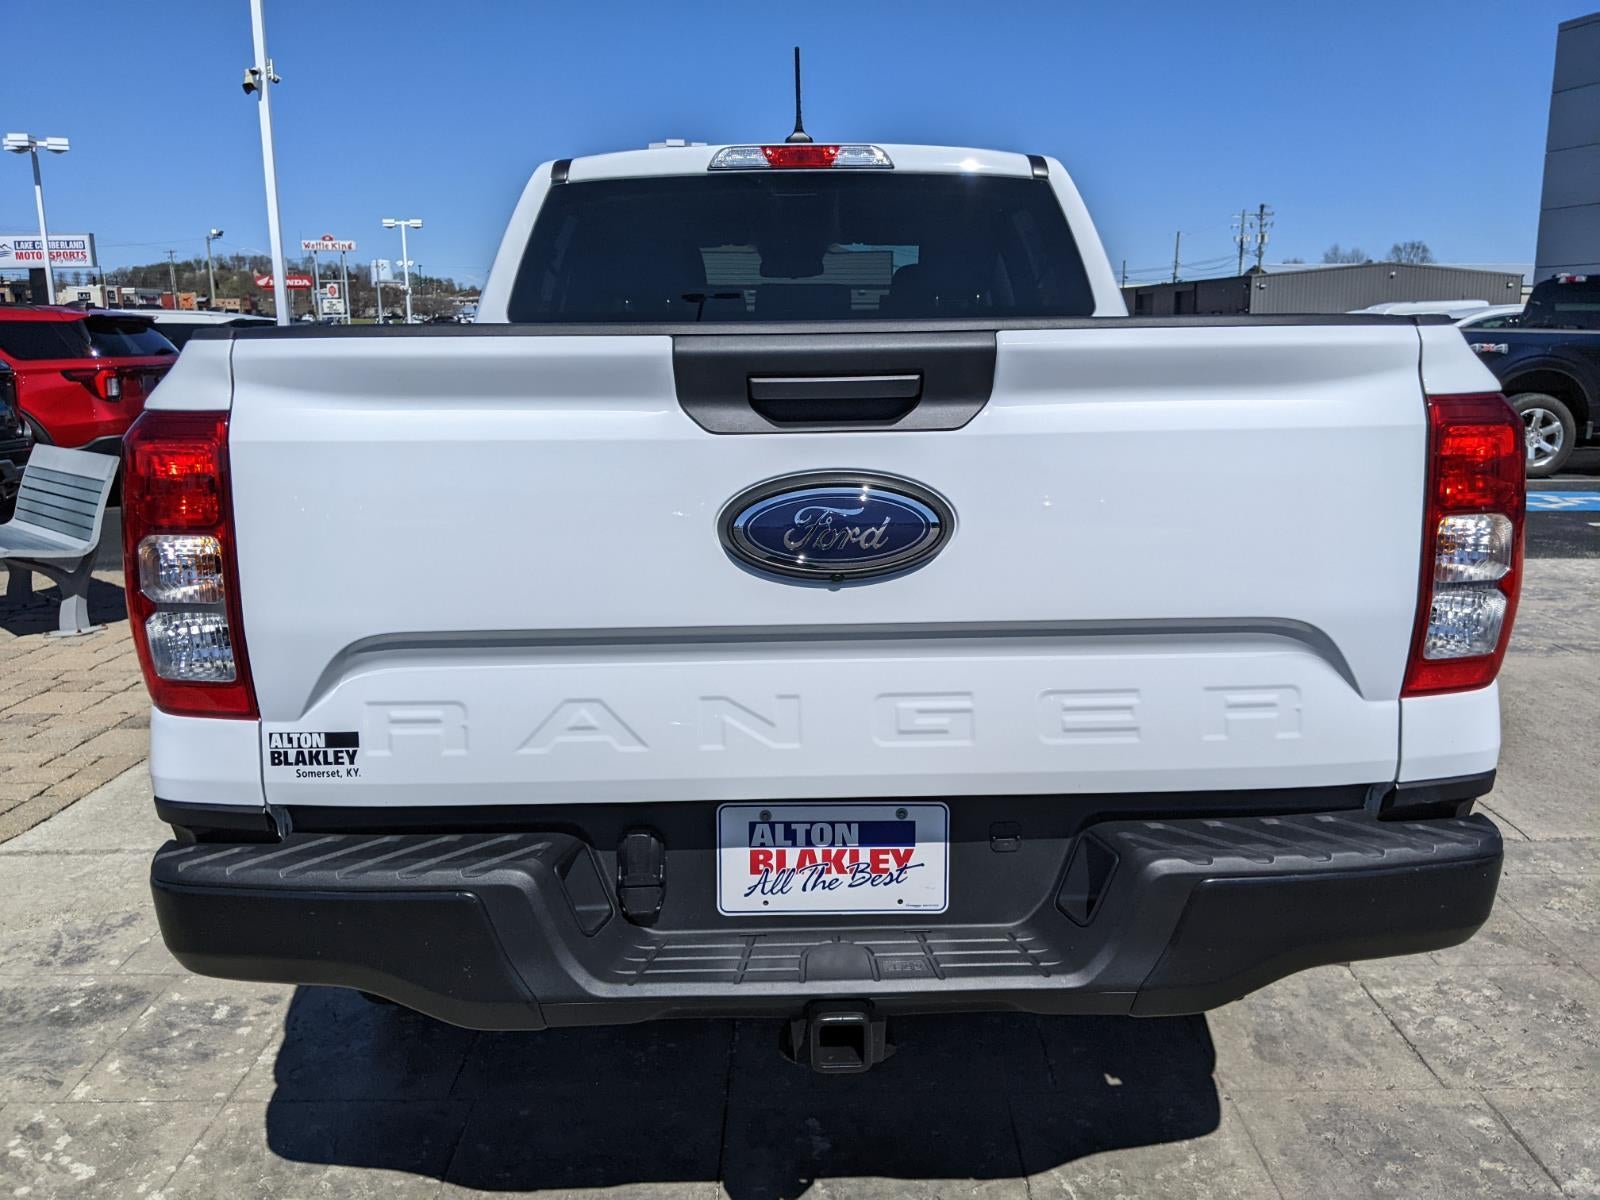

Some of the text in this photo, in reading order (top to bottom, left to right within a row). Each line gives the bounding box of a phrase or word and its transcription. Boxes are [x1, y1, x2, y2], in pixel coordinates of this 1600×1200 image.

[15, 241, 34, 250] LAKE
[331, 242, 352, 250] King
[784, 506, 890, 550] Ford
[364, 684, 1302, 757] RANGER
[270, 732, 326, 749] ALTON
[270, 749, 358, 766] BLAKLEY
[296, 767, 361, 778] Somerset, KY.
[750, 823, 859, 847] ALTON
[750, 848, 915, 875] BLAKLEY
[744, 862, 925, 897] All The Best
